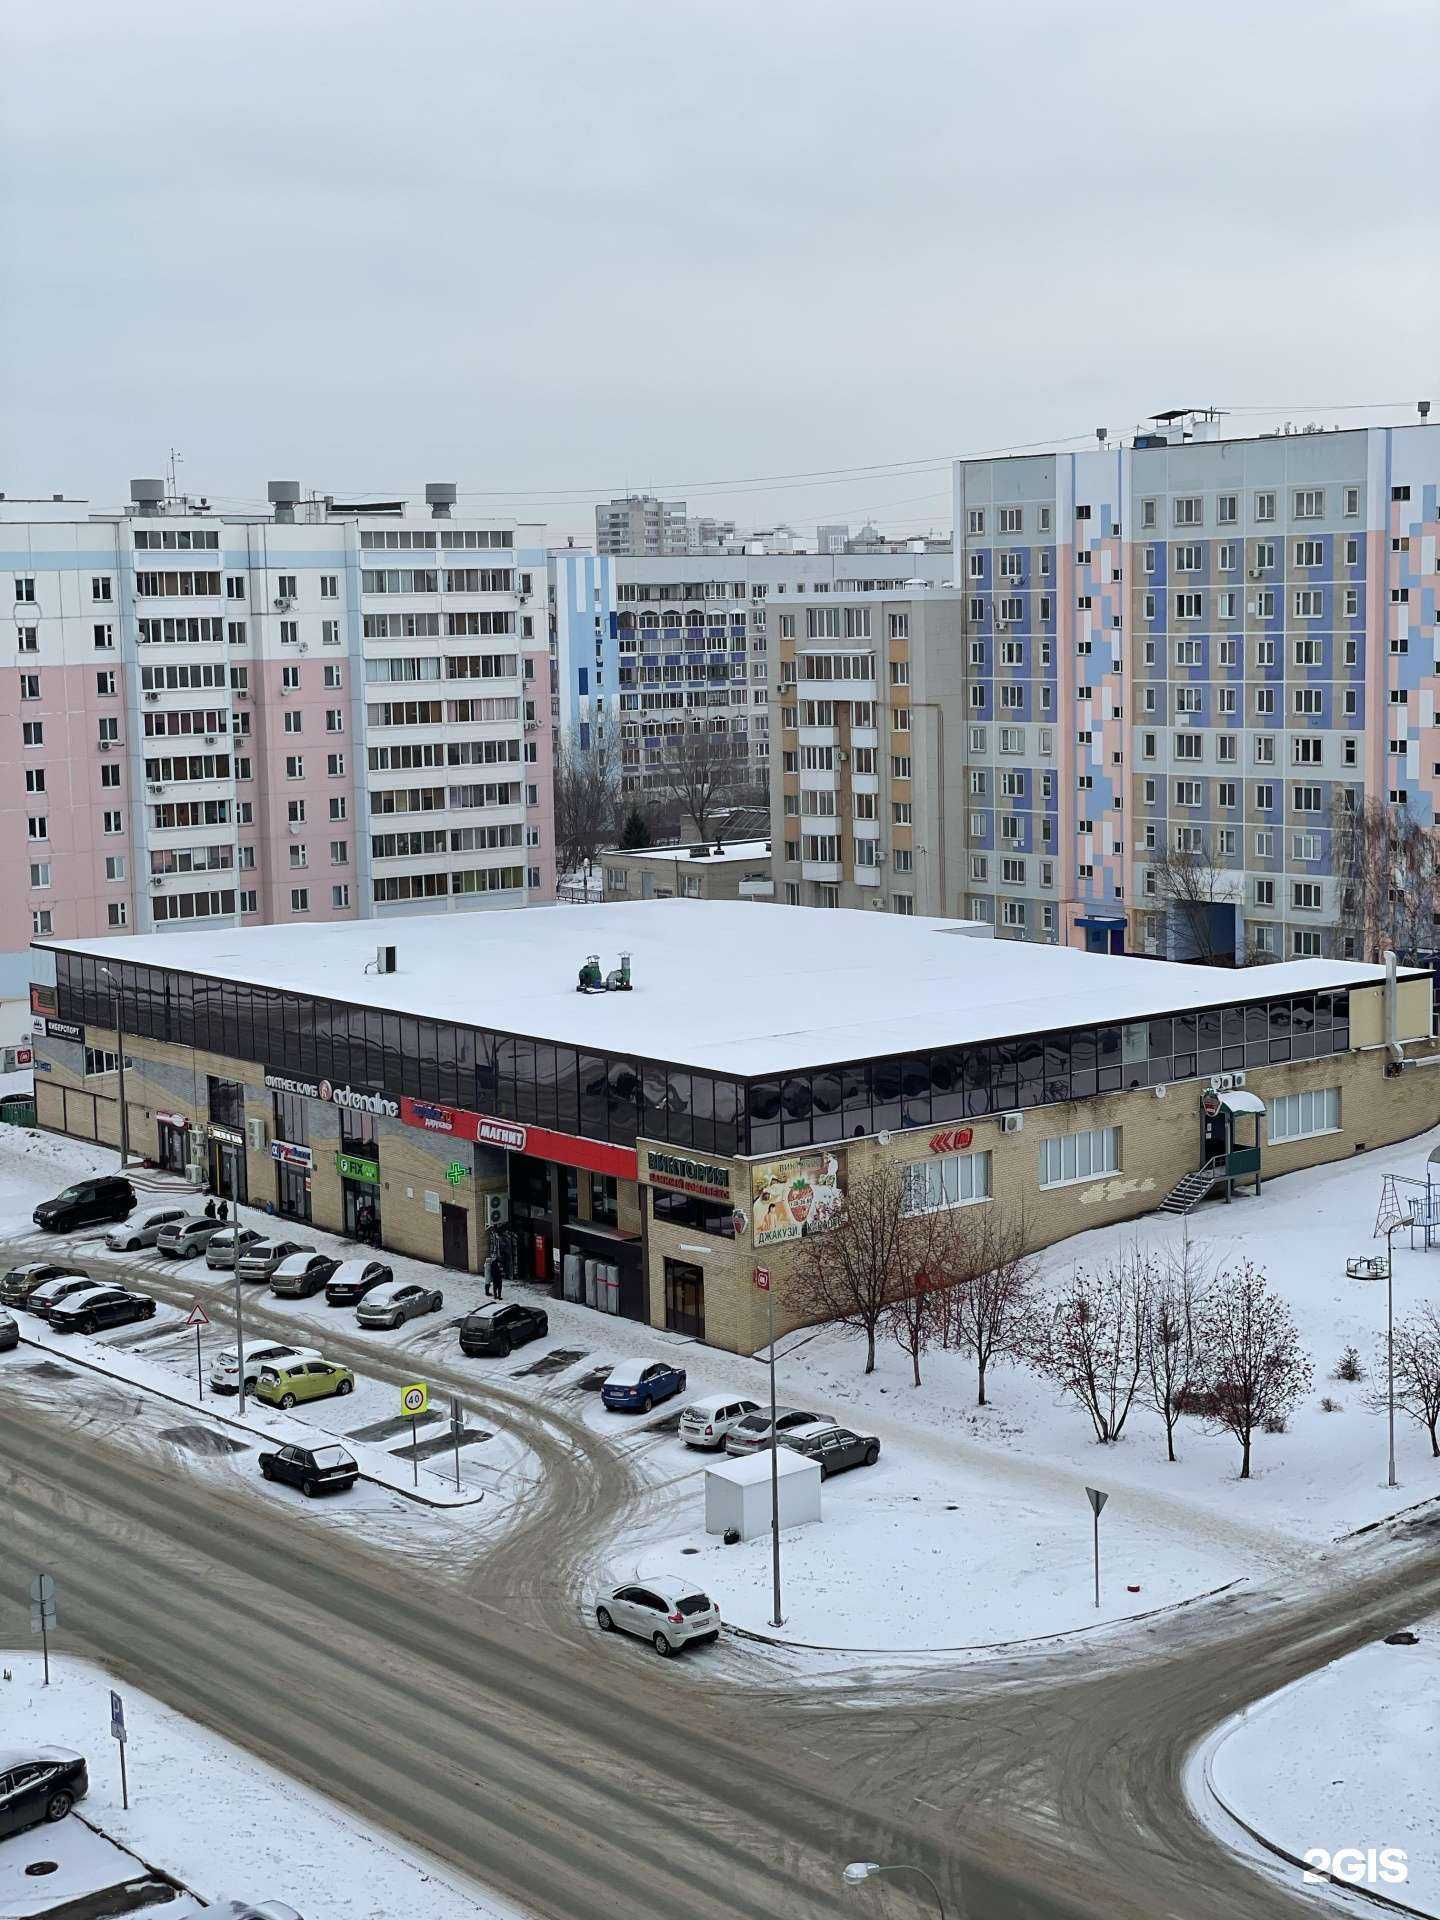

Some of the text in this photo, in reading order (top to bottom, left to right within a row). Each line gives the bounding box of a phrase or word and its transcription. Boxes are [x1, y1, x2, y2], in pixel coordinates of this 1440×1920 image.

[265, 1074, 319, 1097] ФИТНЕС КЛУБ
[332, 1085, 399, 1117] adrenaline
[480, 1124, 523, 1145] МАГНИТ
[648, 1151, 729, 1187] ВИКТОРИЯ
[408, 1394, 420, 1404] 40
